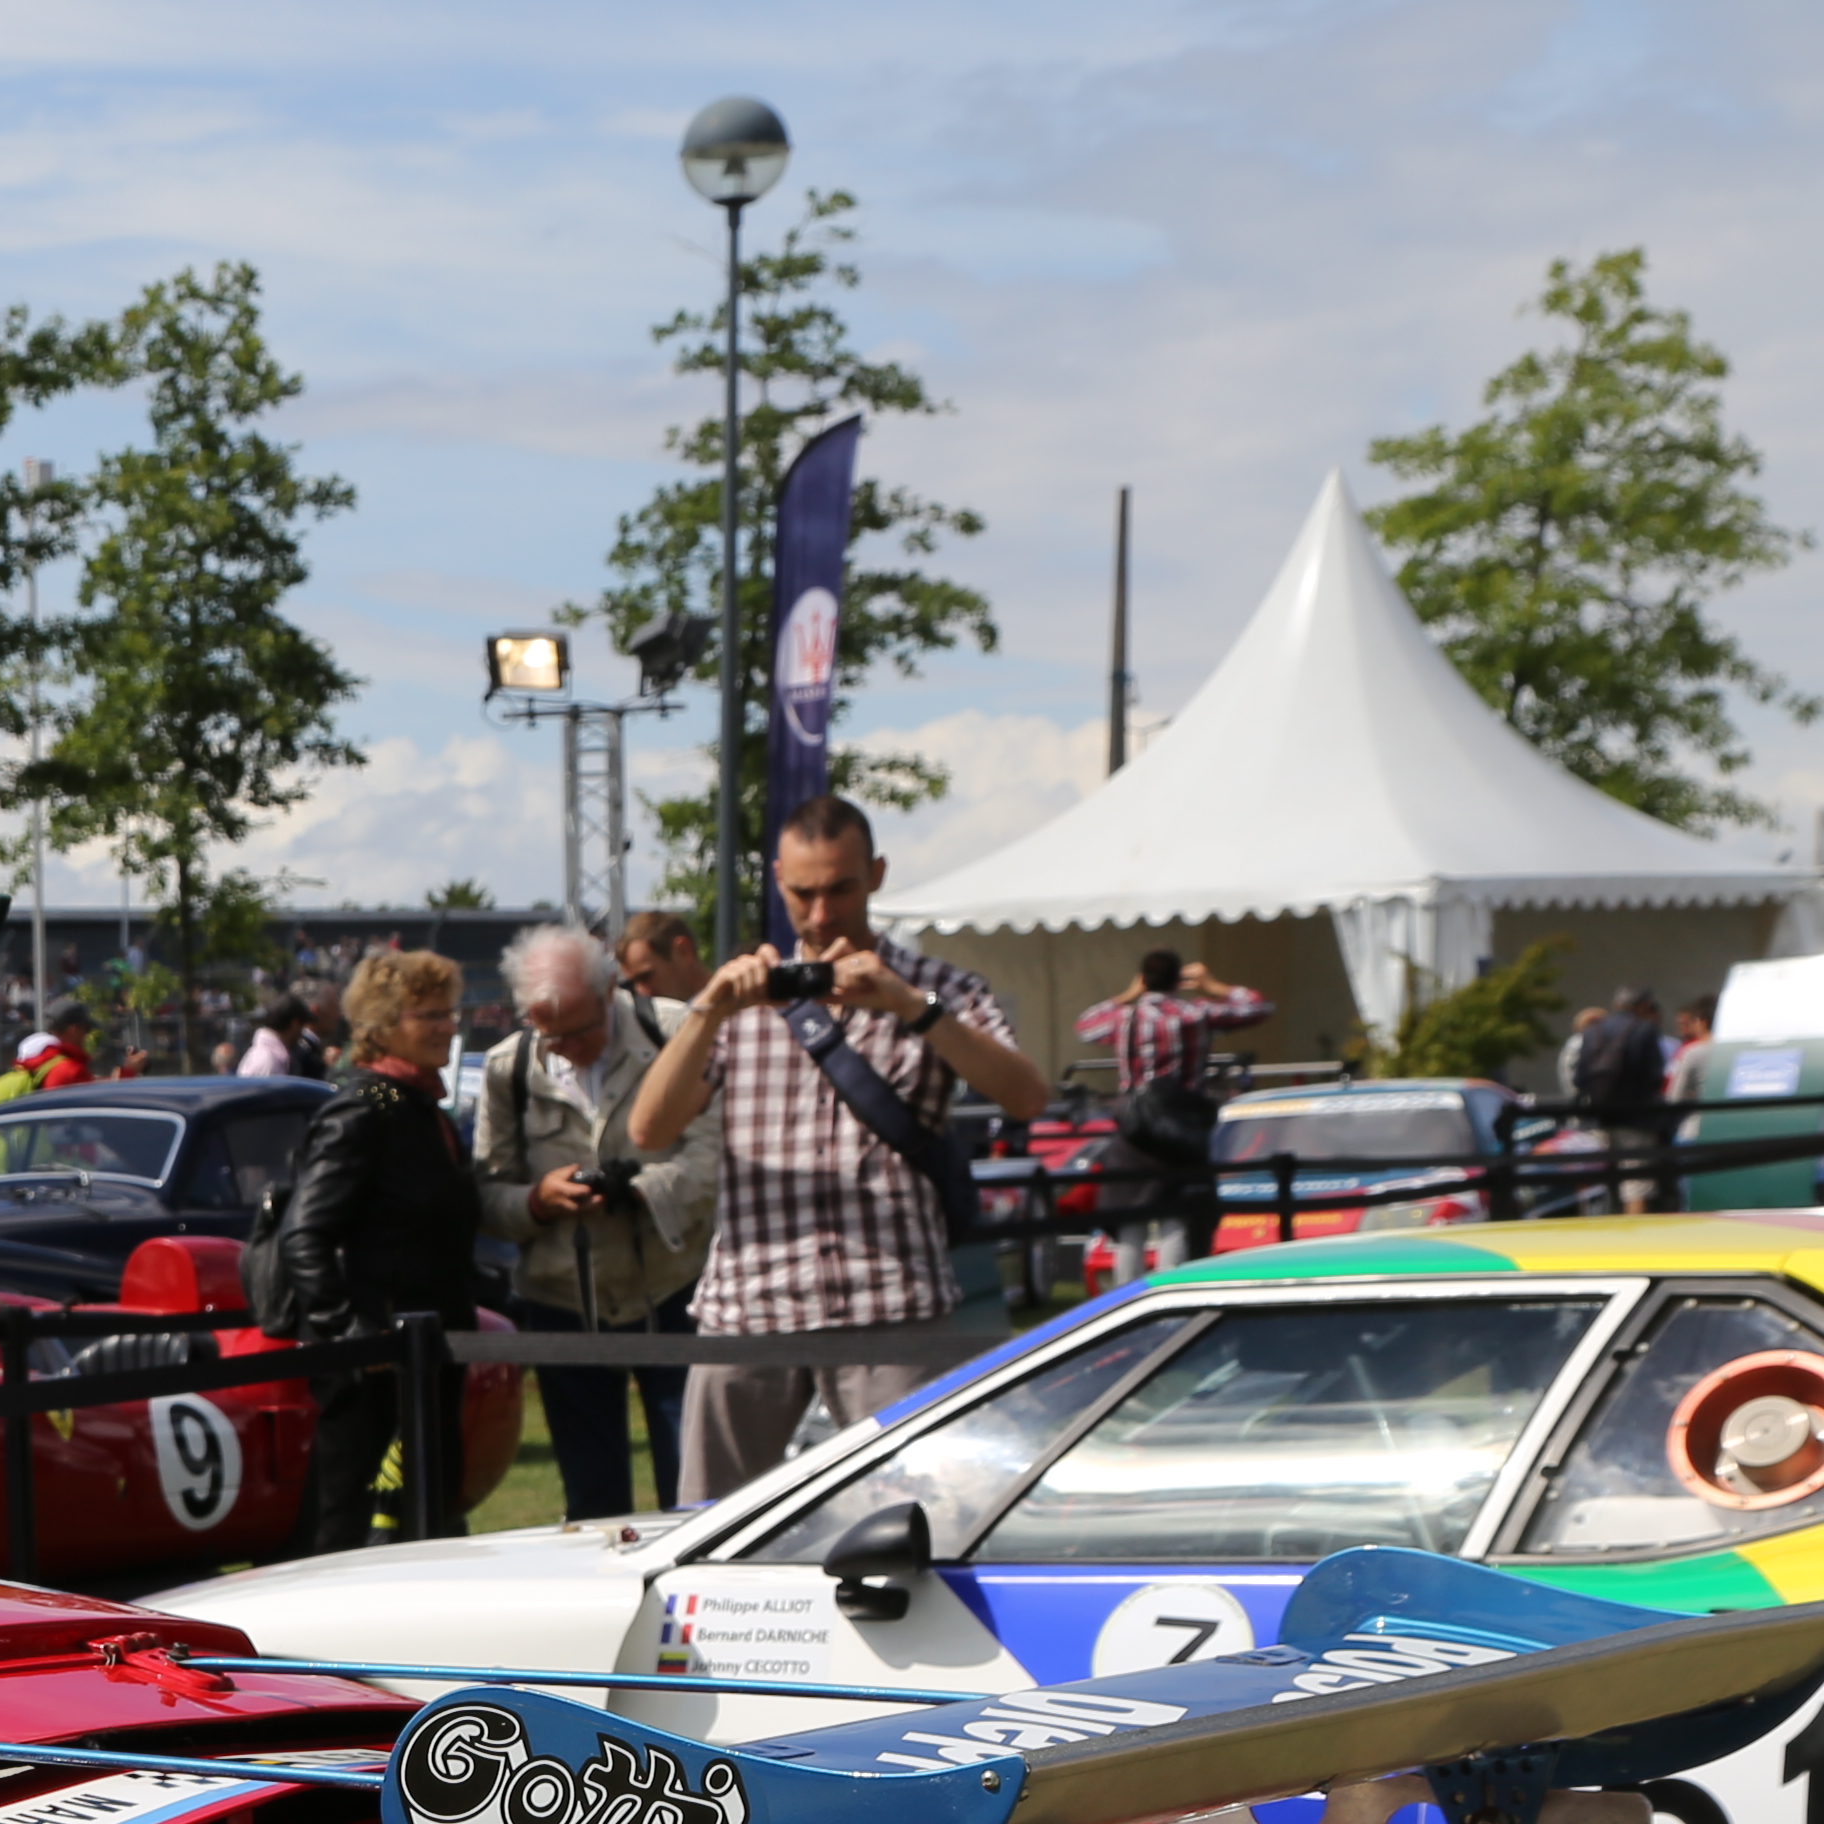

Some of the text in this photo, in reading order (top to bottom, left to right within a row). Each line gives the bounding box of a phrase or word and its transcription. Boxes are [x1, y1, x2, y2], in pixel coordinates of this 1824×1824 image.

[169, 1401, 225, 1519] 9
[702, 1597, 813, 1615] Philippe ALLIOT
[696, 1627, 830, 1644] Bernard DARNICHE
[1154, 1617, 1221, 1667] 7
[691, 1658, 811, 1676] Johnny CECOTTO
